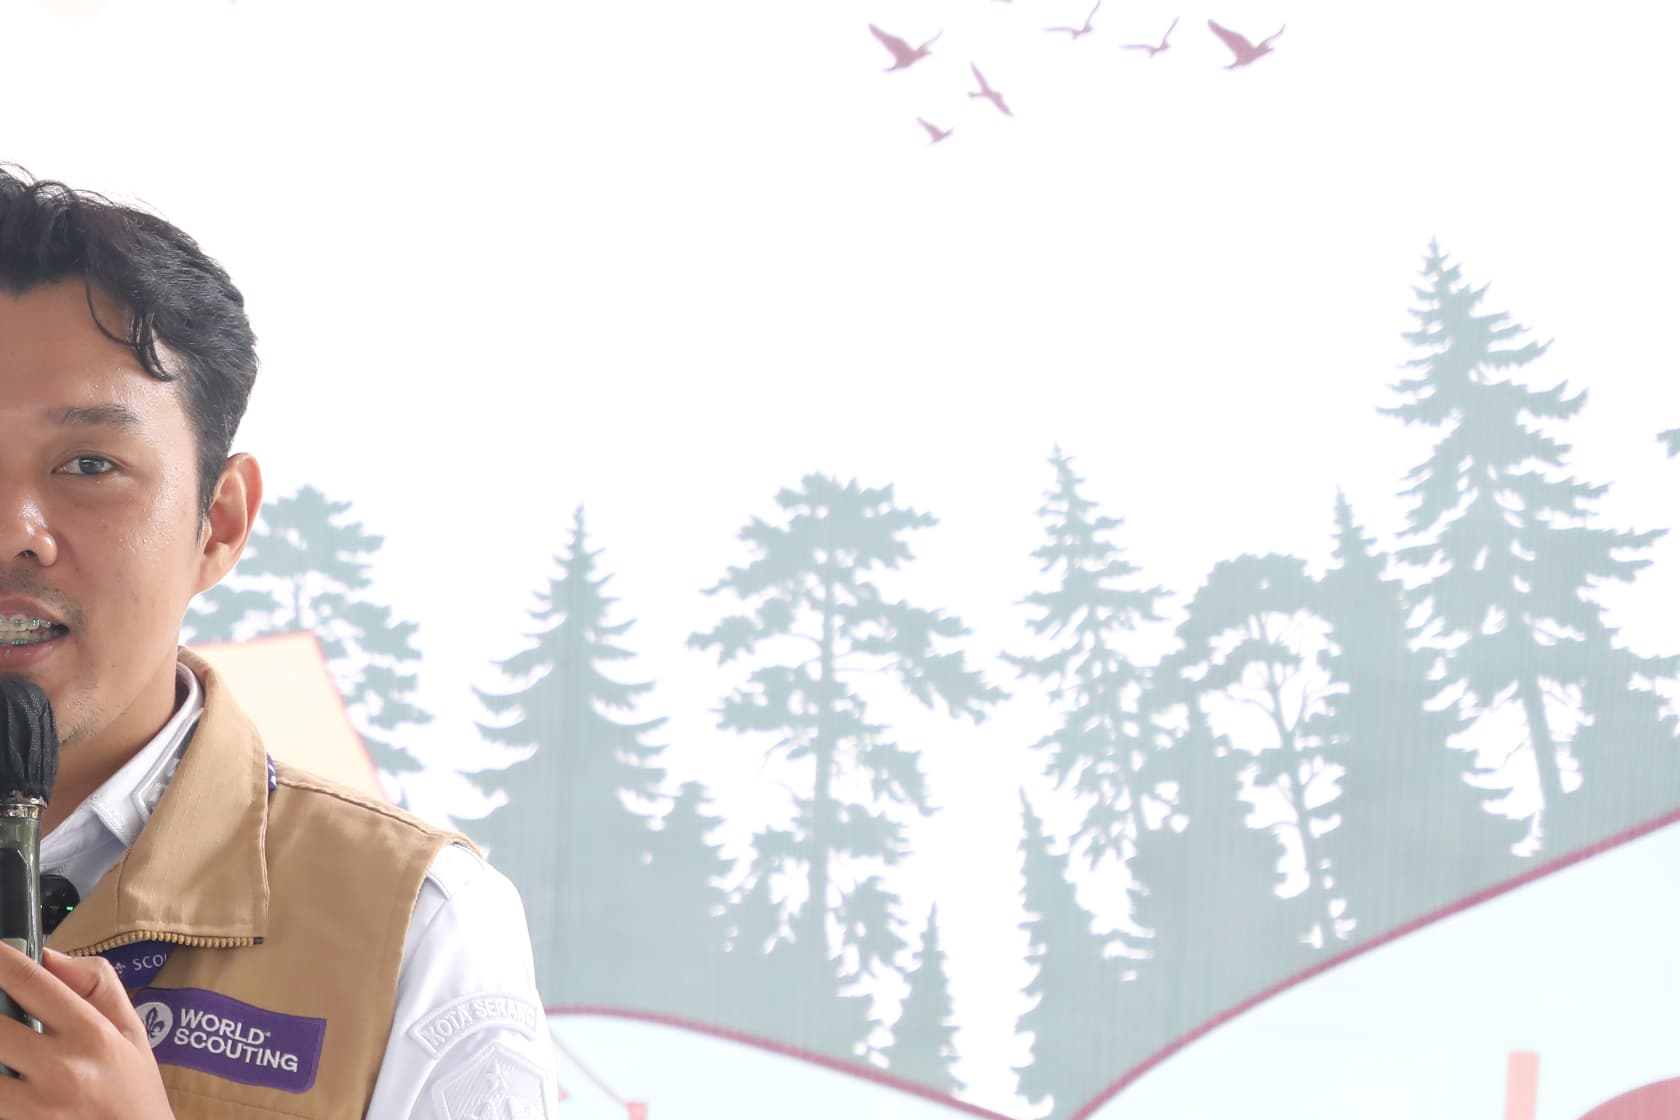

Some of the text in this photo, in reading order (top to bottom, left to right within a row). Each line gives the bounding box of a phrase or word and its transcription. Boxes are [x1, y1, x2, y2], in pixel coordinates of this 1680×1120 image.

[132, 952, 167, 971] SCO
[180, 1007, 264, 1045] WORLD
[421, 1002, 473, 1047] KOTA
[174, 1028, 299, 1073] SCOUTING
